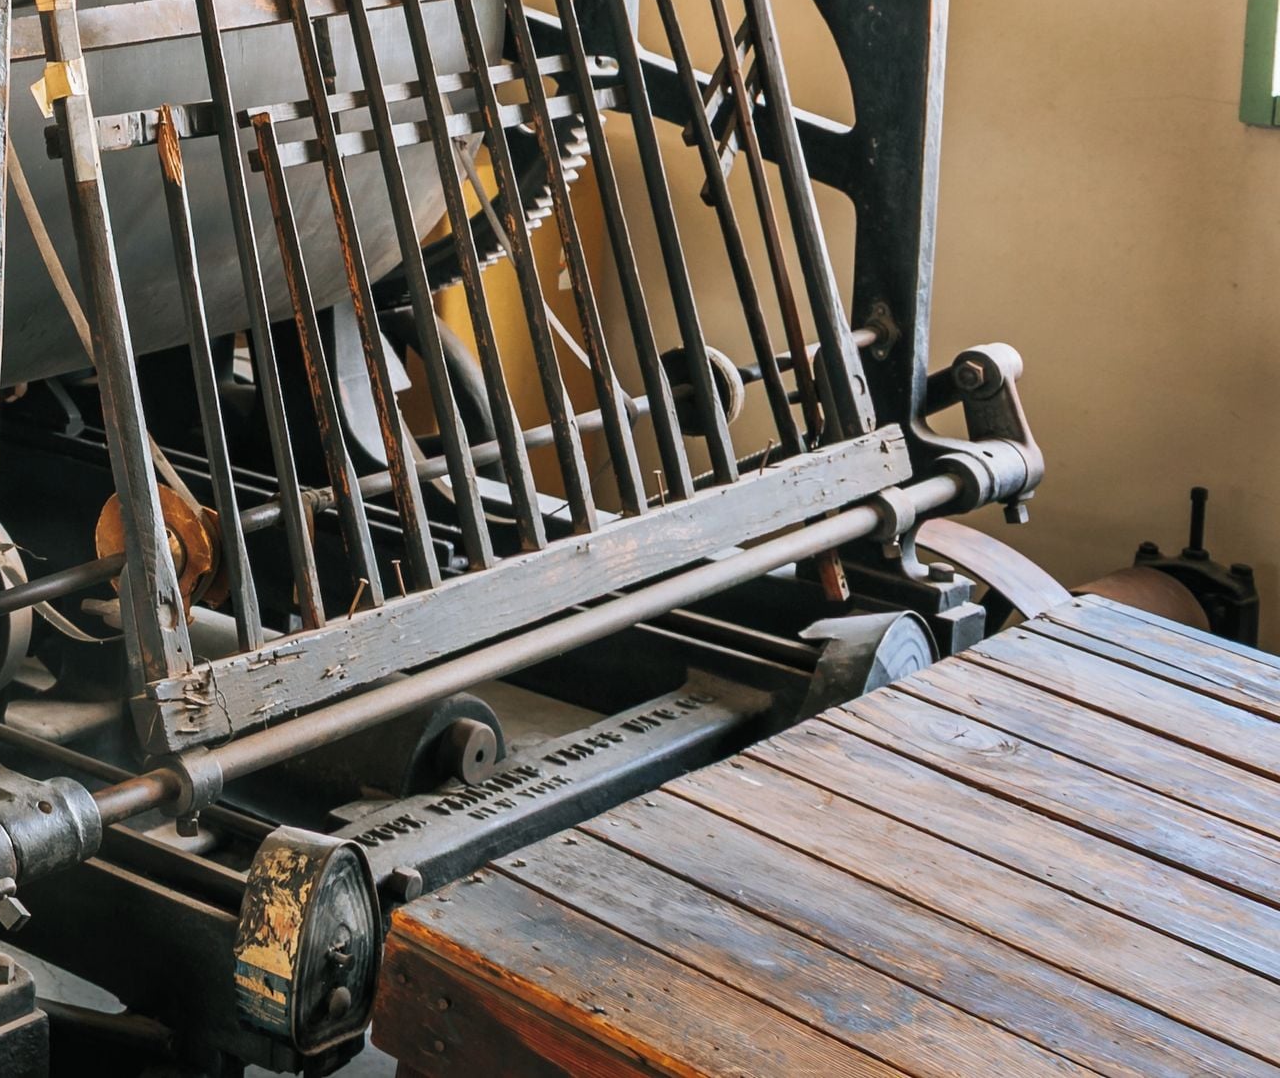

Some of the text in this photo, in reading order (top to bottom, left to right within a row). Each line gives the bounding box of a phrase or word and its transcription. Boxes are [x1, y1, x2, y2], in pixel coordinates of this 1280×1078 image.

[542, 730, 627, 767] PRESS
[467, 774, 573, 821] NEW YORK
